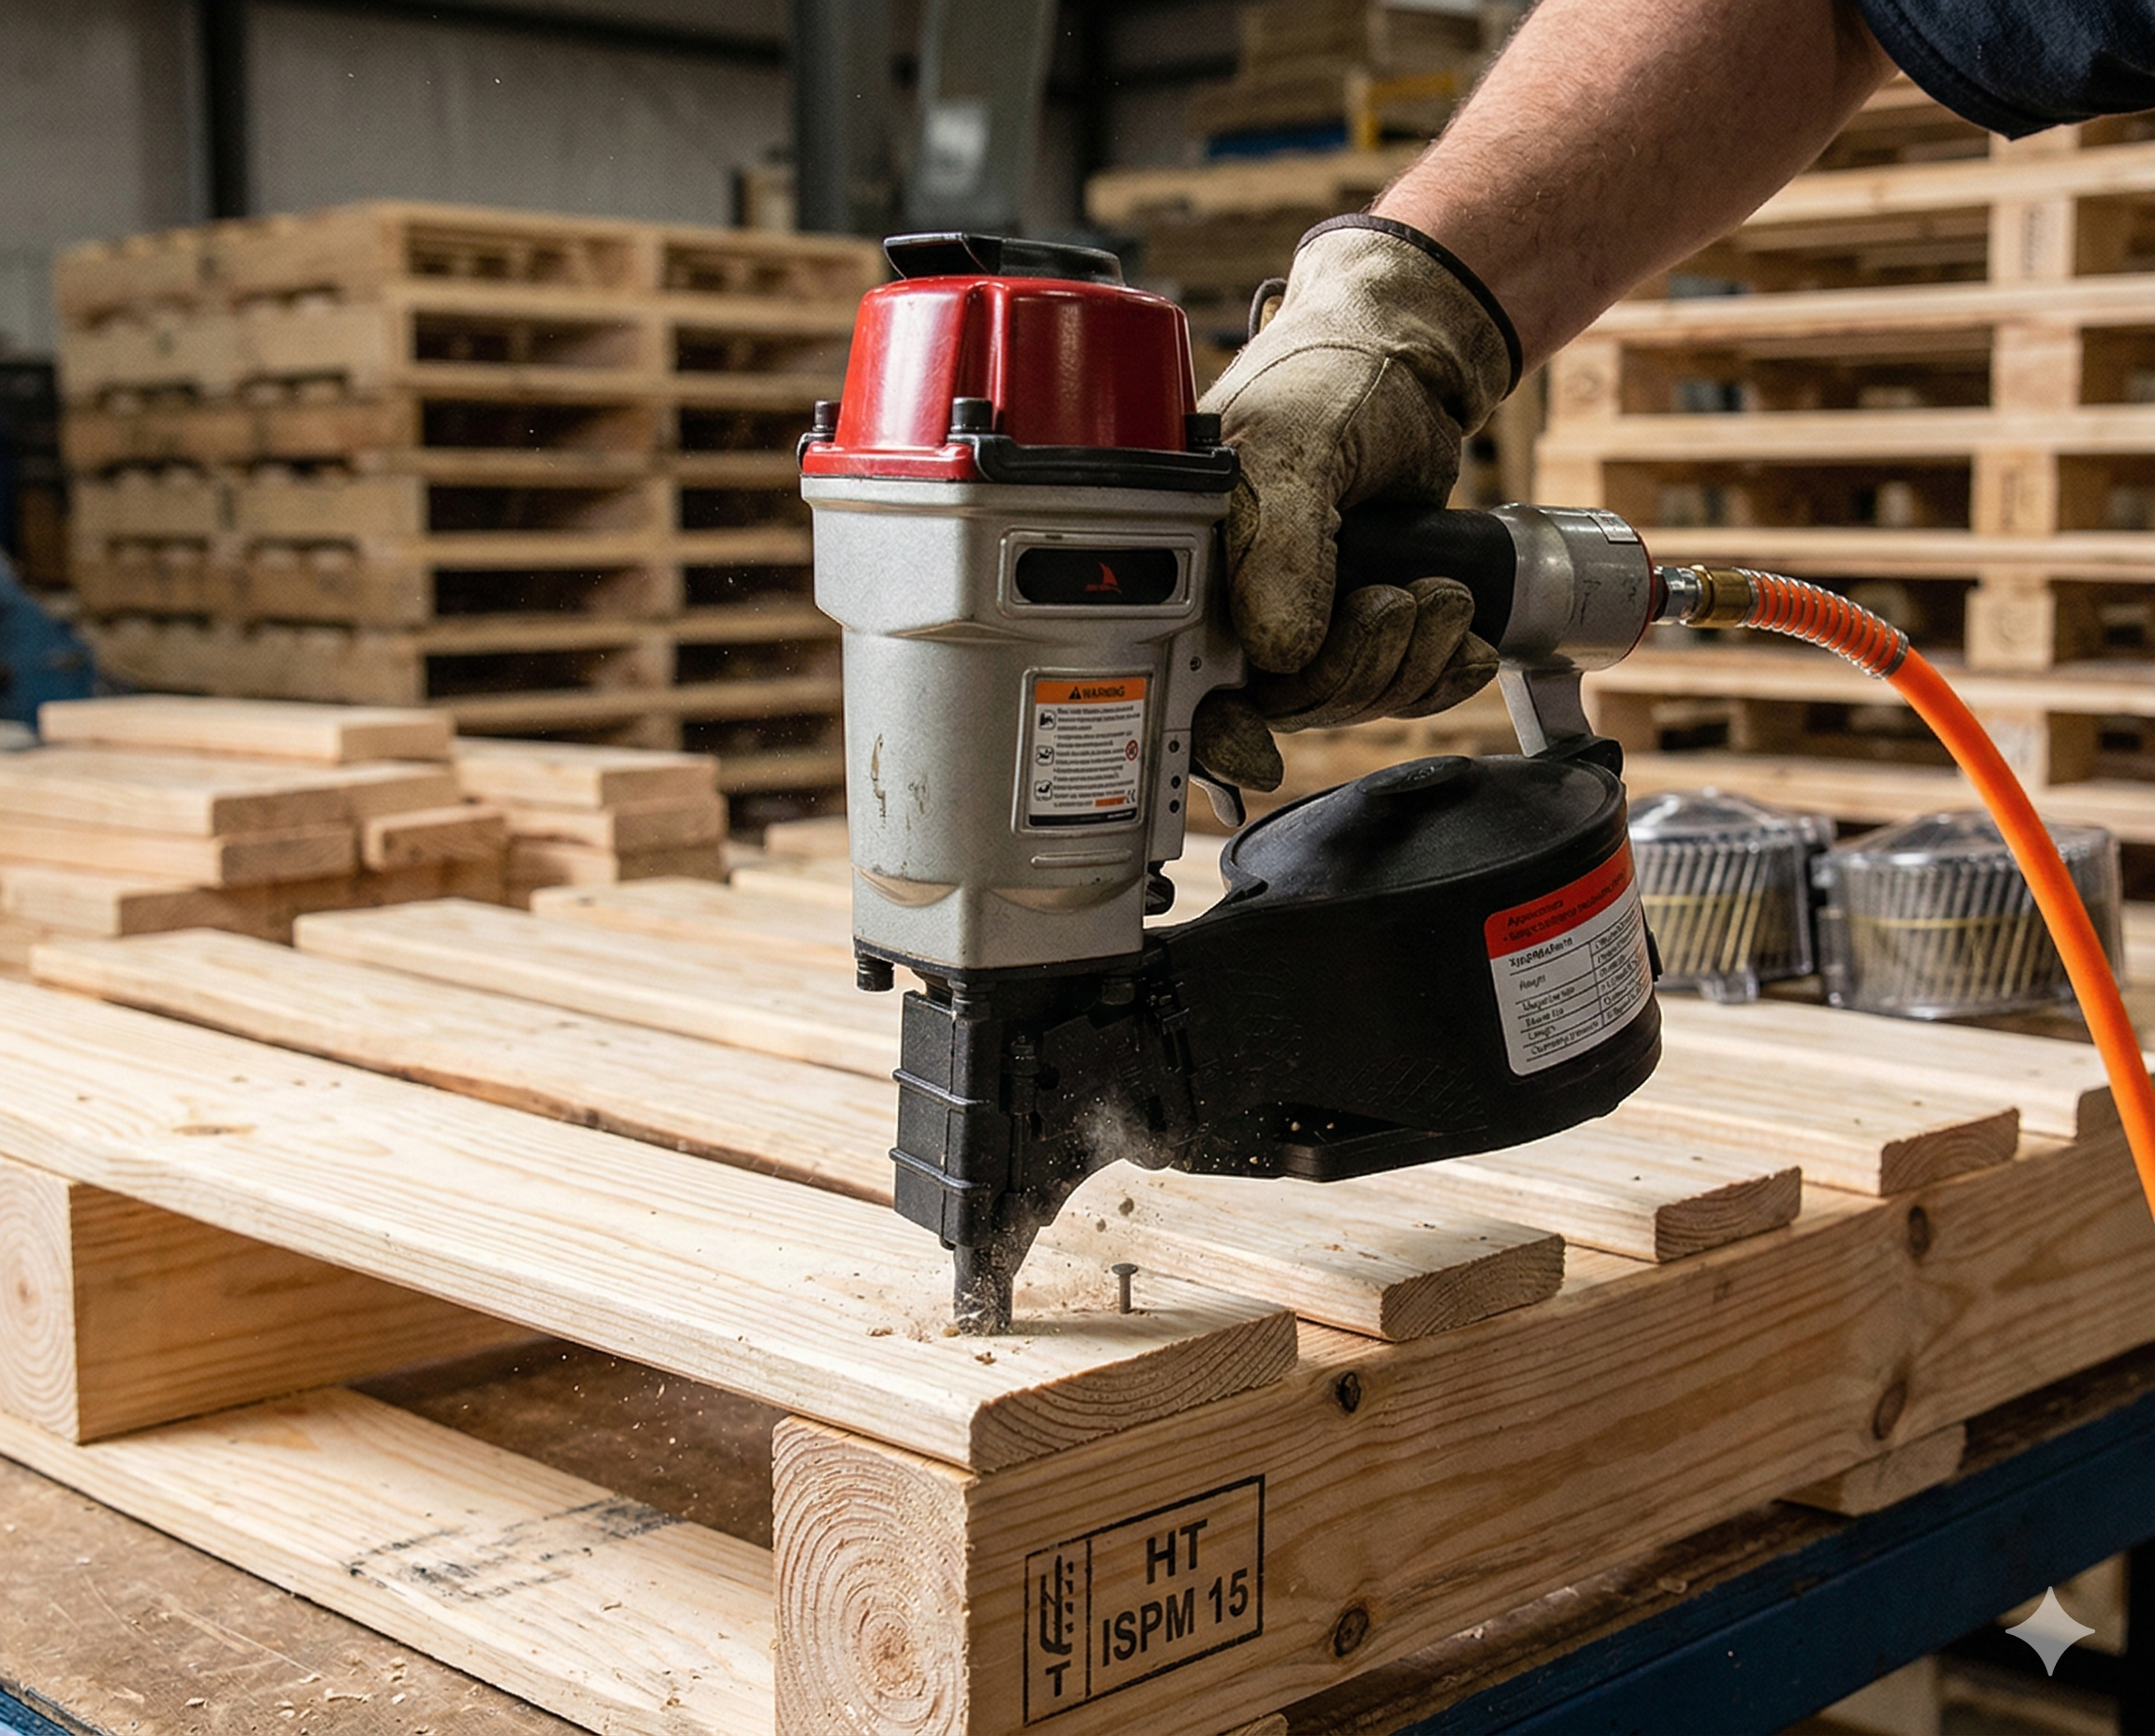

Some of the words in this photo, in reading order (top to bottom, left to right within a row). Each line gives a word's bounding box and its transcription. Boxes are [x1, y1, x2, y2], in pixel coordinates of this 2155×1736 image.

[1146, 1518, 1208, 1585] HT
[1102, 1587, 1195, 1668] ISPM
[1208, 1568, 1251, 1625] 15
